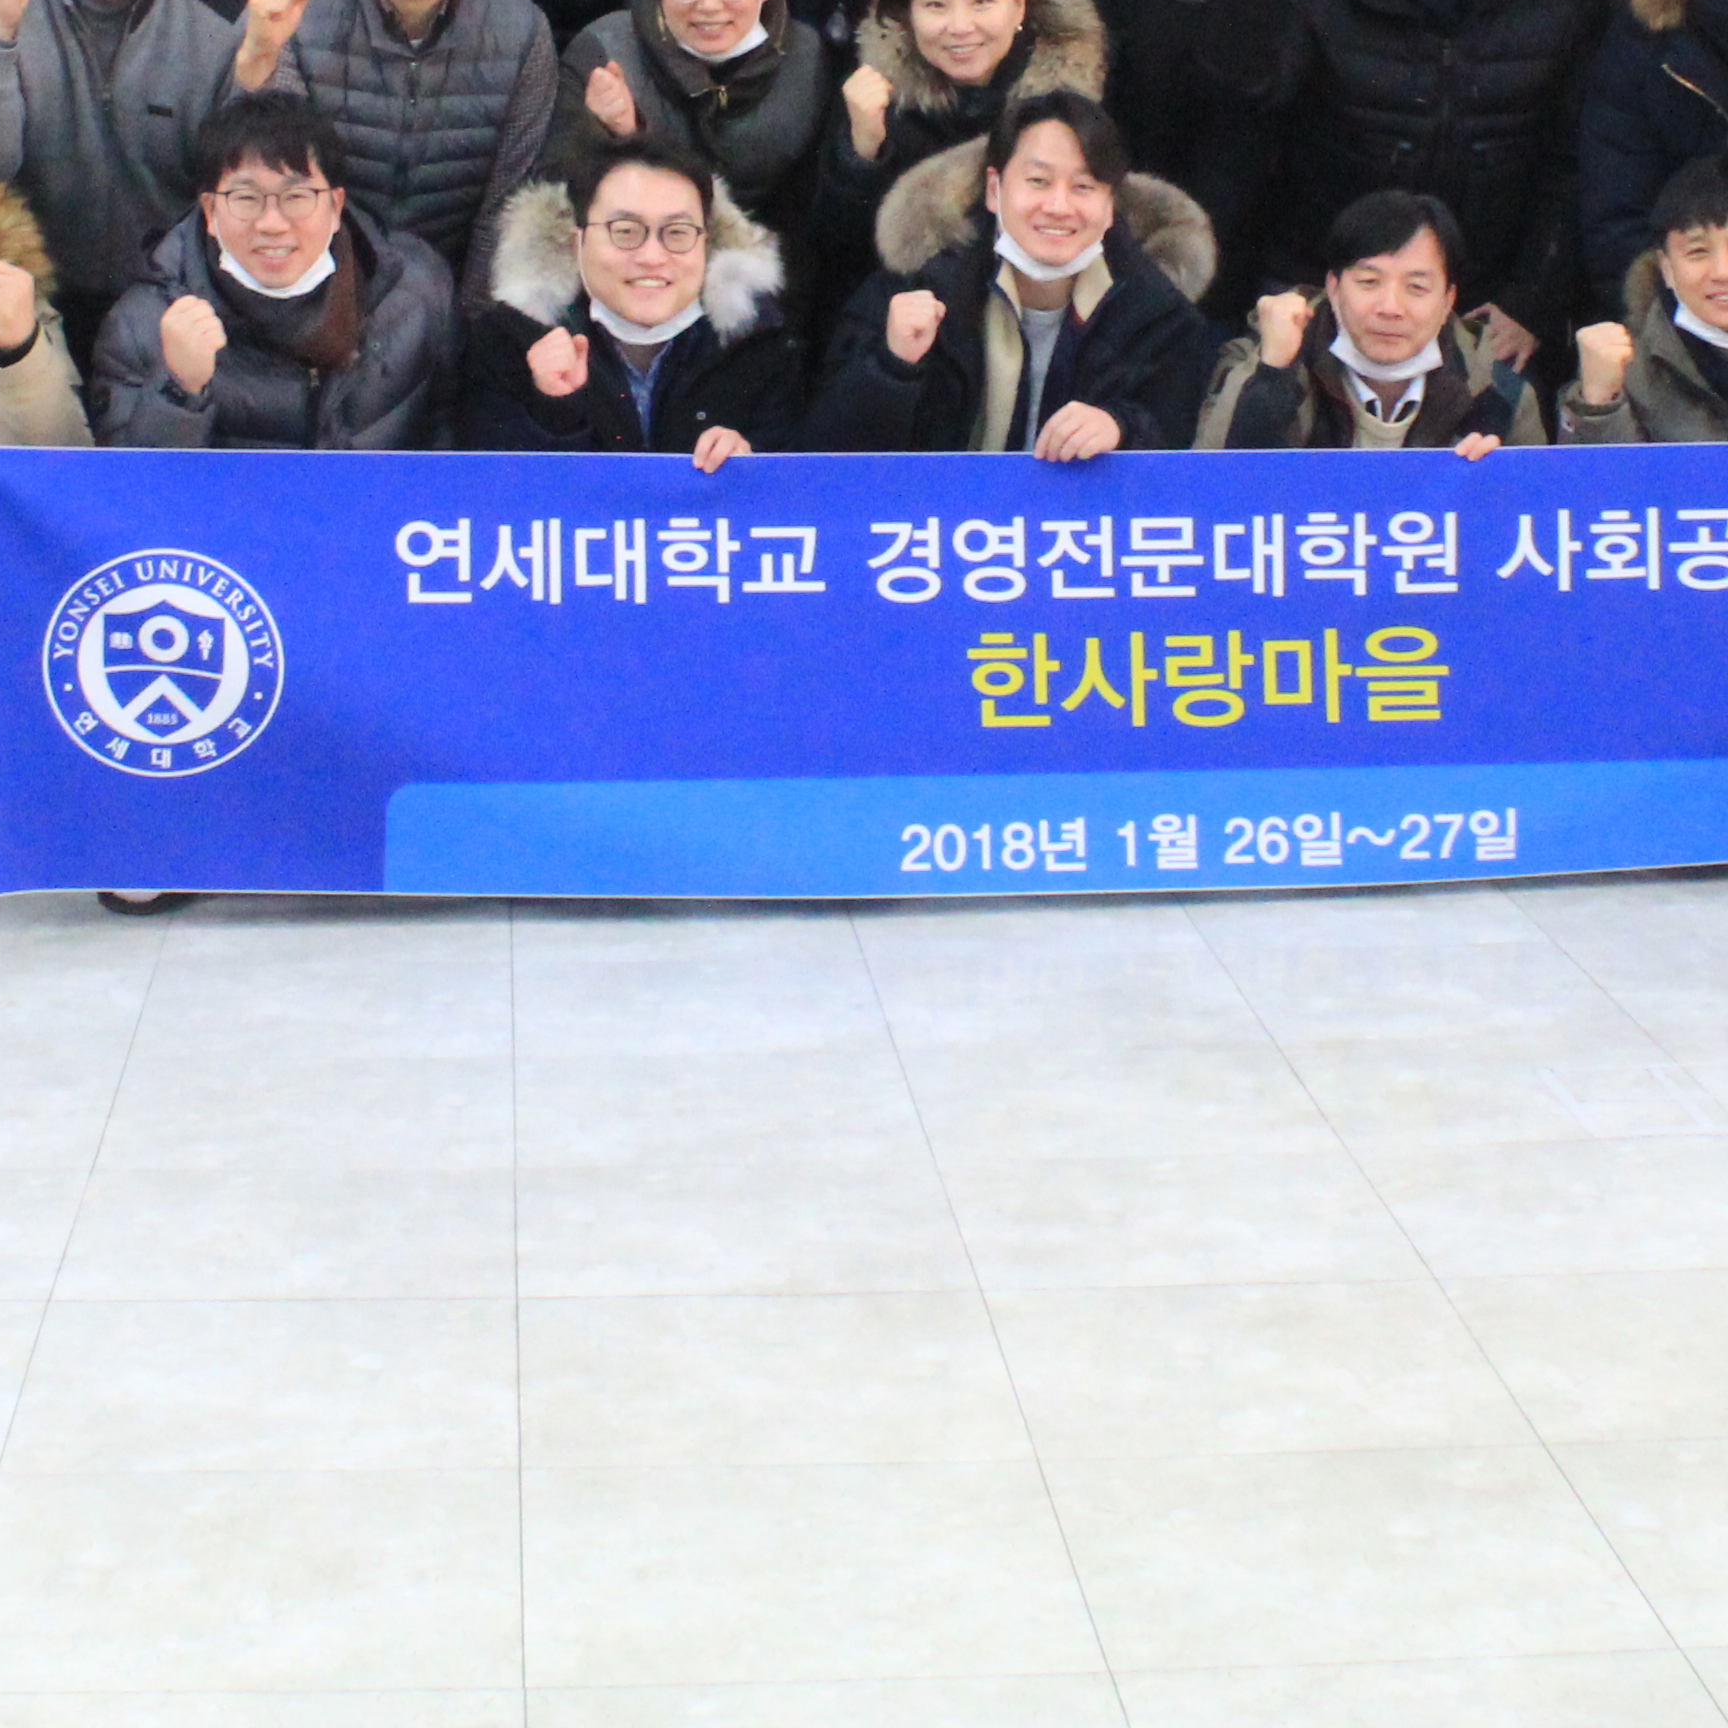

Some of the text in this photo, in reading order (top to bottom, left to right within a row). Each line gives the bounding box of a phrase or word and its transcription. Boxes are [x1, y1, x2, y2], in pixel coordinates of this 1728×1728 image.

[394, 515, 828, 607] 연세대학교
[867, 509, 1462, 605] 경영전문대학원
[53, 558, 275, 669] YONSEI UNIVERSITY
[966, 624, 1452, 729] 한사랑마을
[72, 710, 253, 769] 연세대학교
[145, 712, 179, 726] 1885
[900, 807, 1519, 874] 2018년 1월 26일~27일
